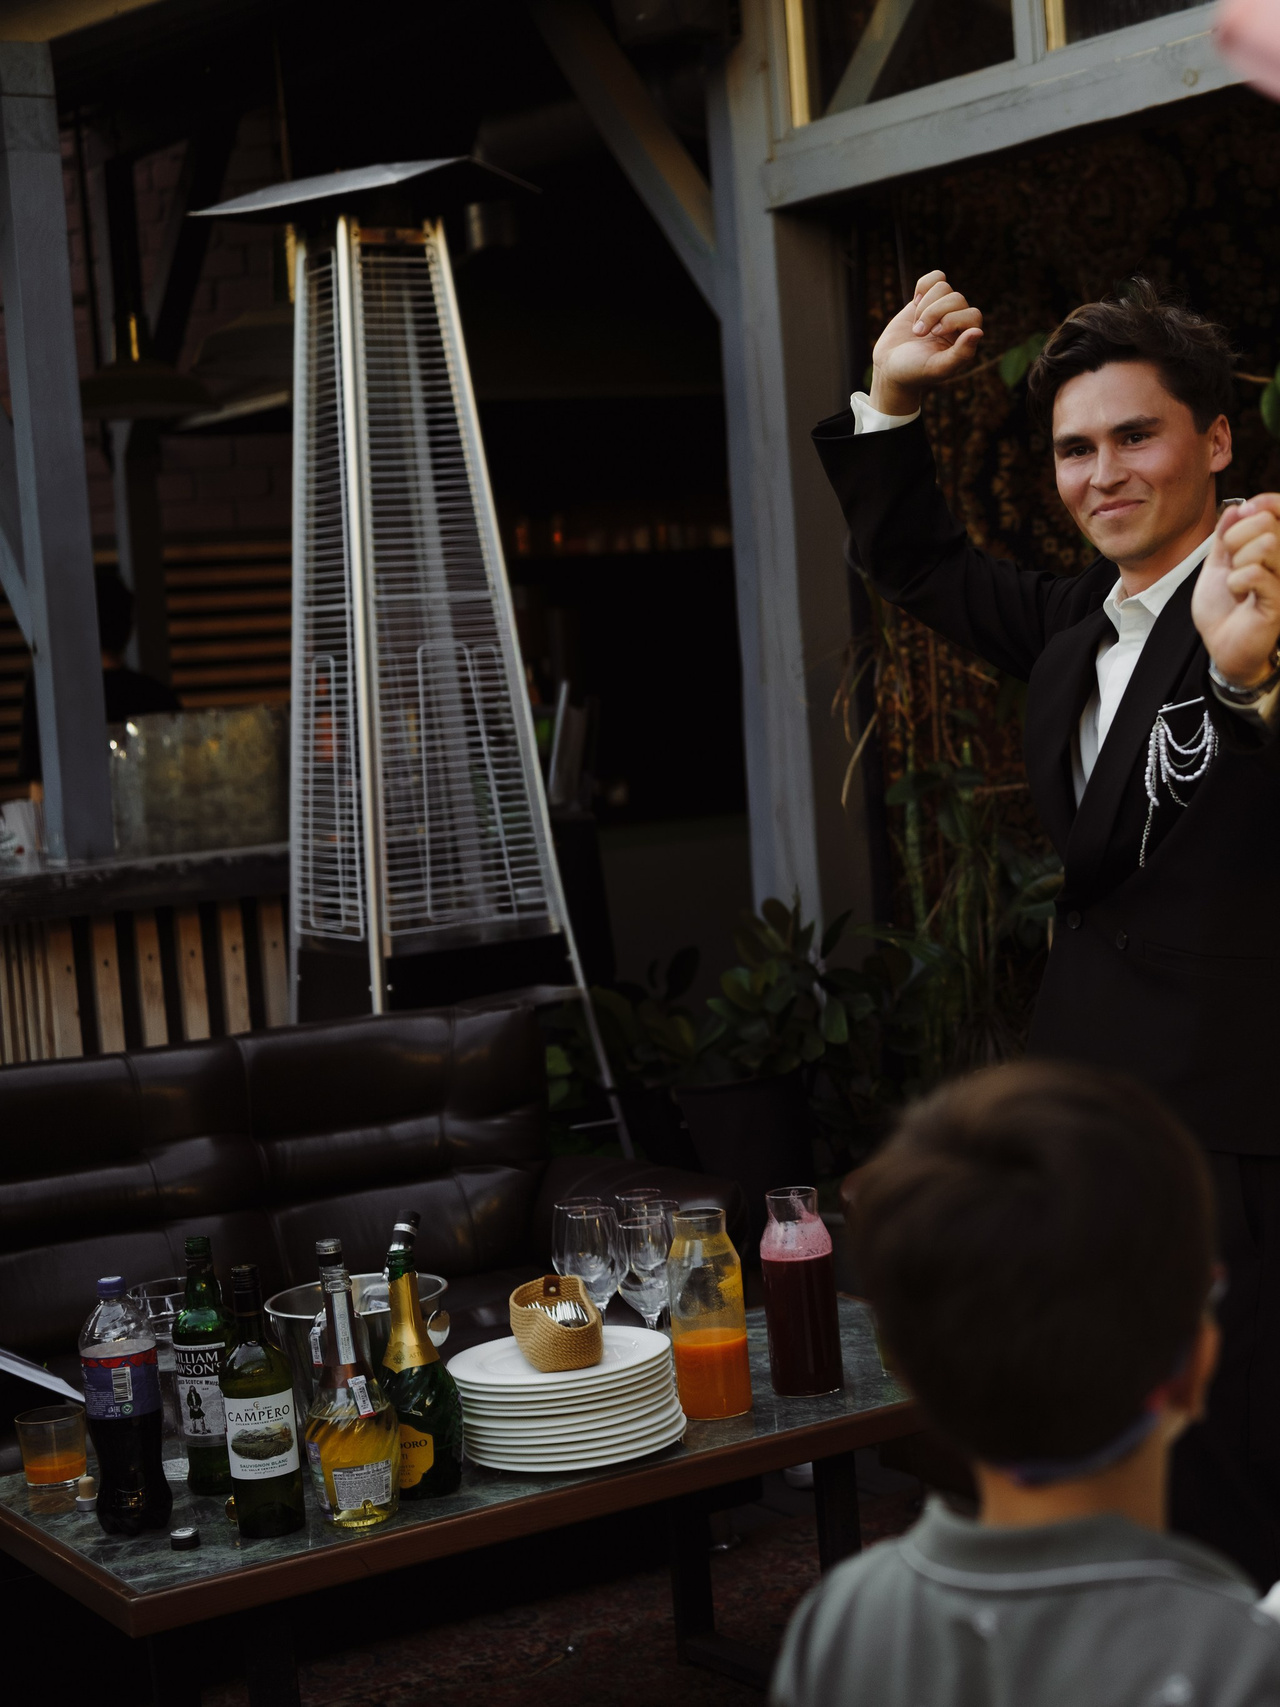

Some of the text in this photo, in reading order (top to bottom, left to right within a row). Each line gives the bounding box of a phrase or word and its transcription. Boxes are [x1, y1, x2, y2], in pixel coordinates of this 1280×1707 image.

[176, 1351, 218, 1364] ILLIAM
[228, 1404, 290, 1422] CAMPERO
[271, 1458, 288, 1466] BLANC
